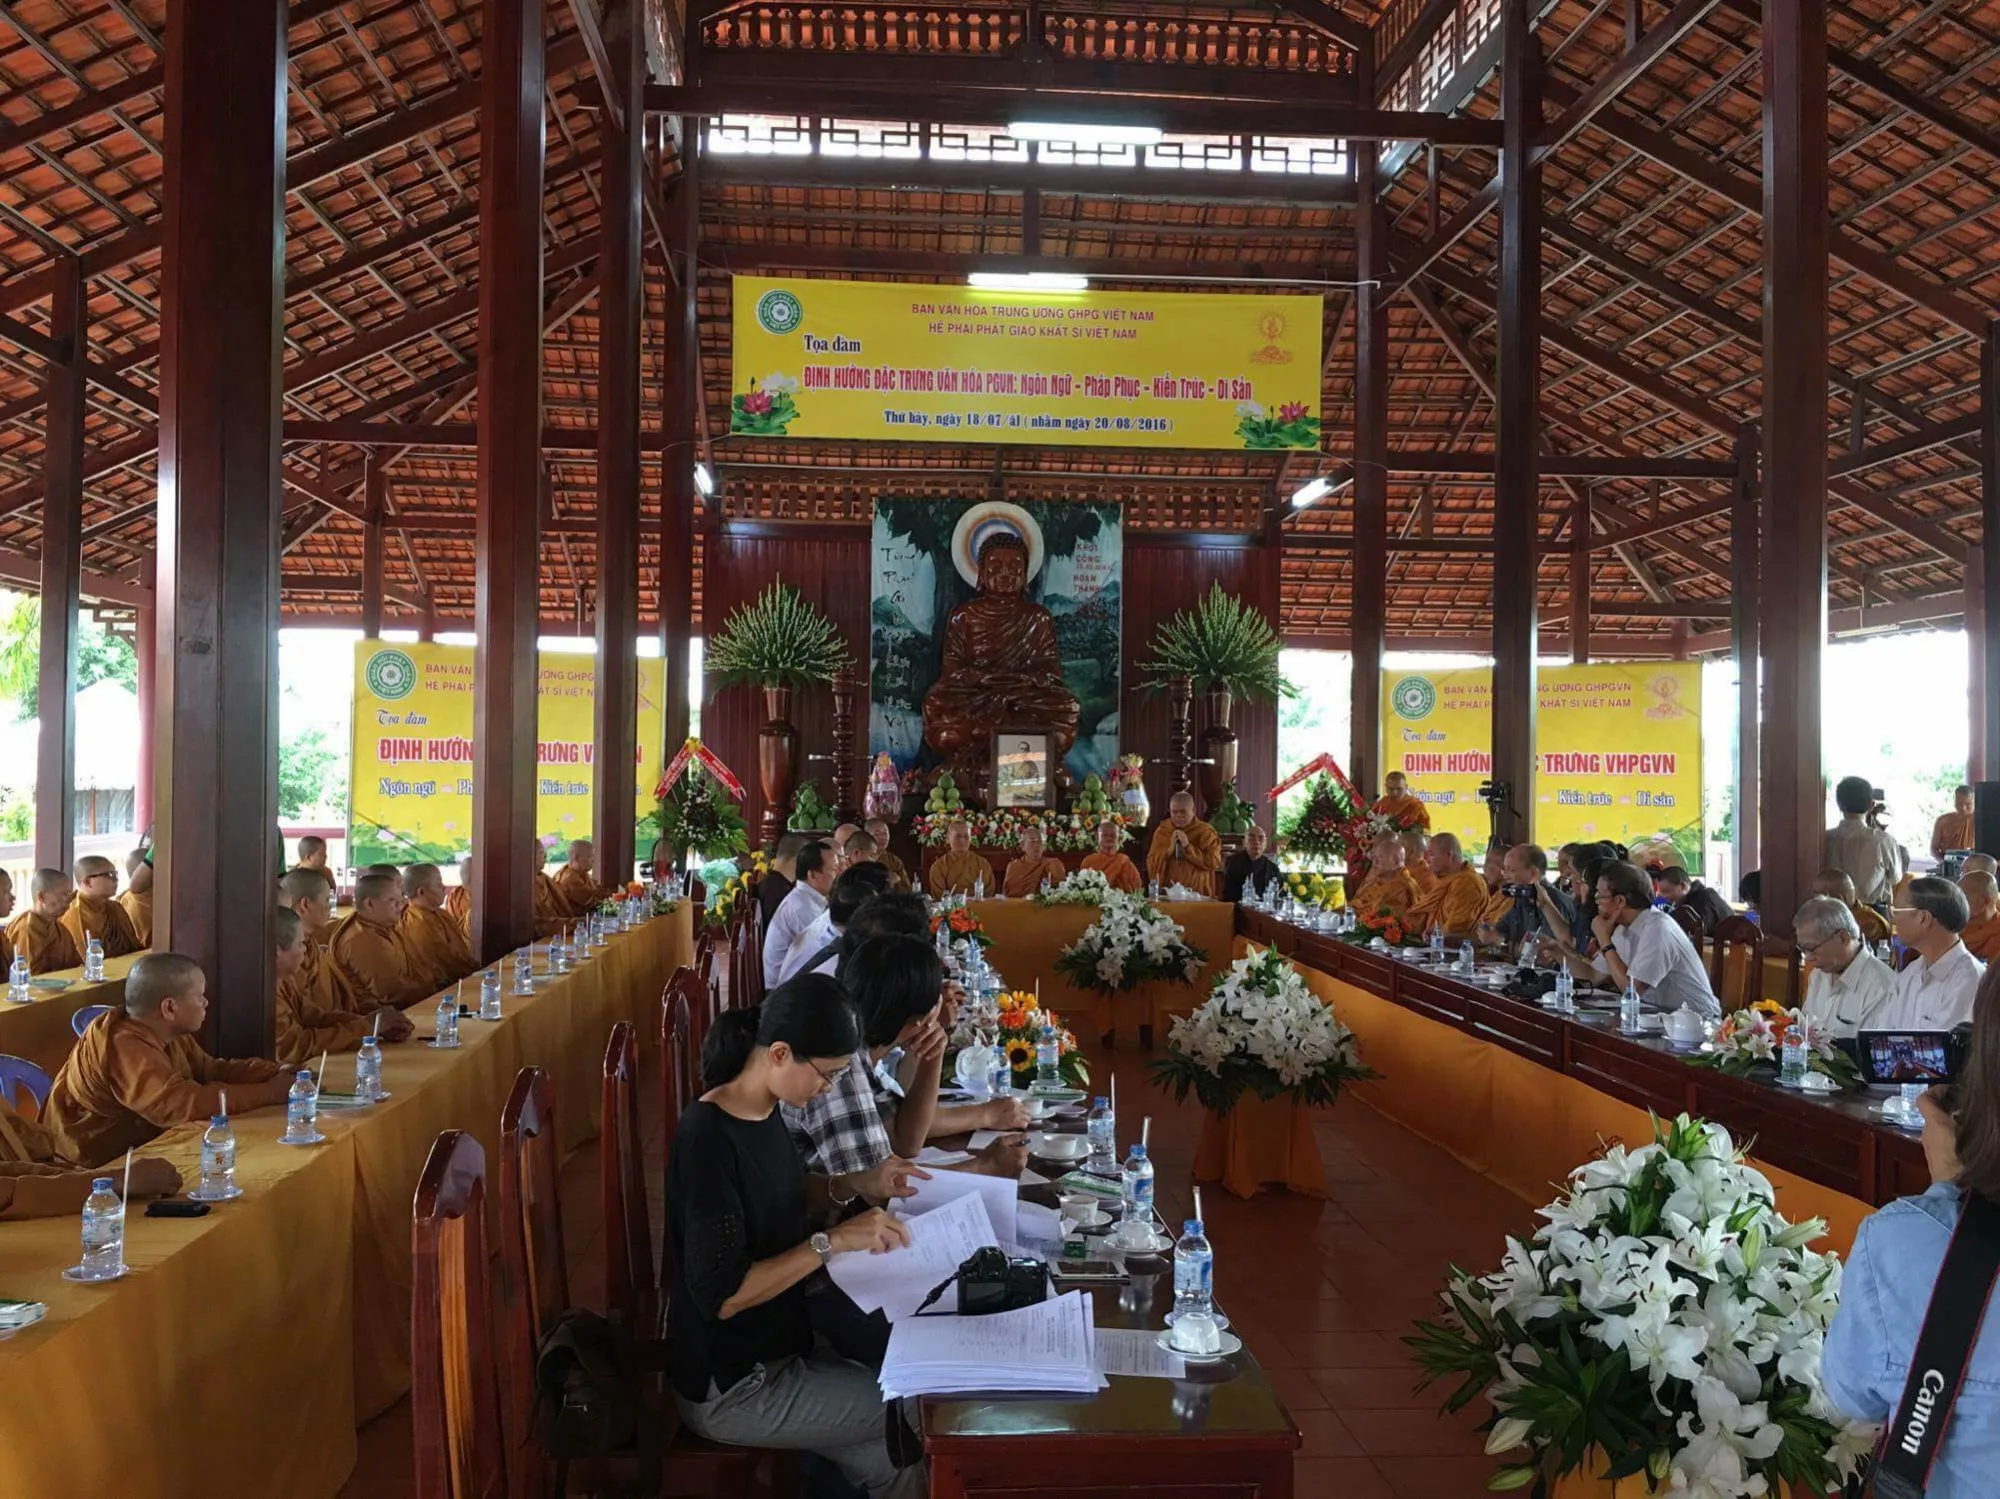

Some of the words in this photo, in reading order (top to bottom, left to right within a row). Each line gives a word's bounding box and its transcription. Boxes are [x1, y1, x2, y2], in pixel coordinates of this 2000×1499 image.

[912, 303, 934, 314] BAN
[991, 306, 1029, 318] TRUNG
[1068, 308, 1099, 320] GHPG
[1130, 310, 1154, 321] NAM
[1113, 327, 1137, 339] NAM
[804, 335, 829, 353] Tọa
[833, 335, 862, 352] đàm
[804, 367, 830, 391] ĐỊNH
[834, 364, 871, 390] HƯỚNG
[874, 366, 895, 395] ĐẶC
[899, 370, 934, 392] TRƯNG
[1094, 417, 1167, 431] 20/08/2016
[425, 664, 447, 674] BAN
[1444, 685, 1464, 694] BAN
[1585, 682, 1631, 692] GHPGVN
[1608, 698, 1631, 708] NAM
[379, 739, 422, 765] ĐỊNH
[428, 736, 474, 762] HƯỚN
[538, 741, 579, 763] RƯNG
[1404, 754, 1442, 776] ĐỊNH
[1447, 750, 1491, 773] HƯỚN
[1545, 752, 1600, 773] TRƯNG
[1605, 753, 1675, 774] VHPGVN
[1901, 1369, 1945, 1456] Canon
